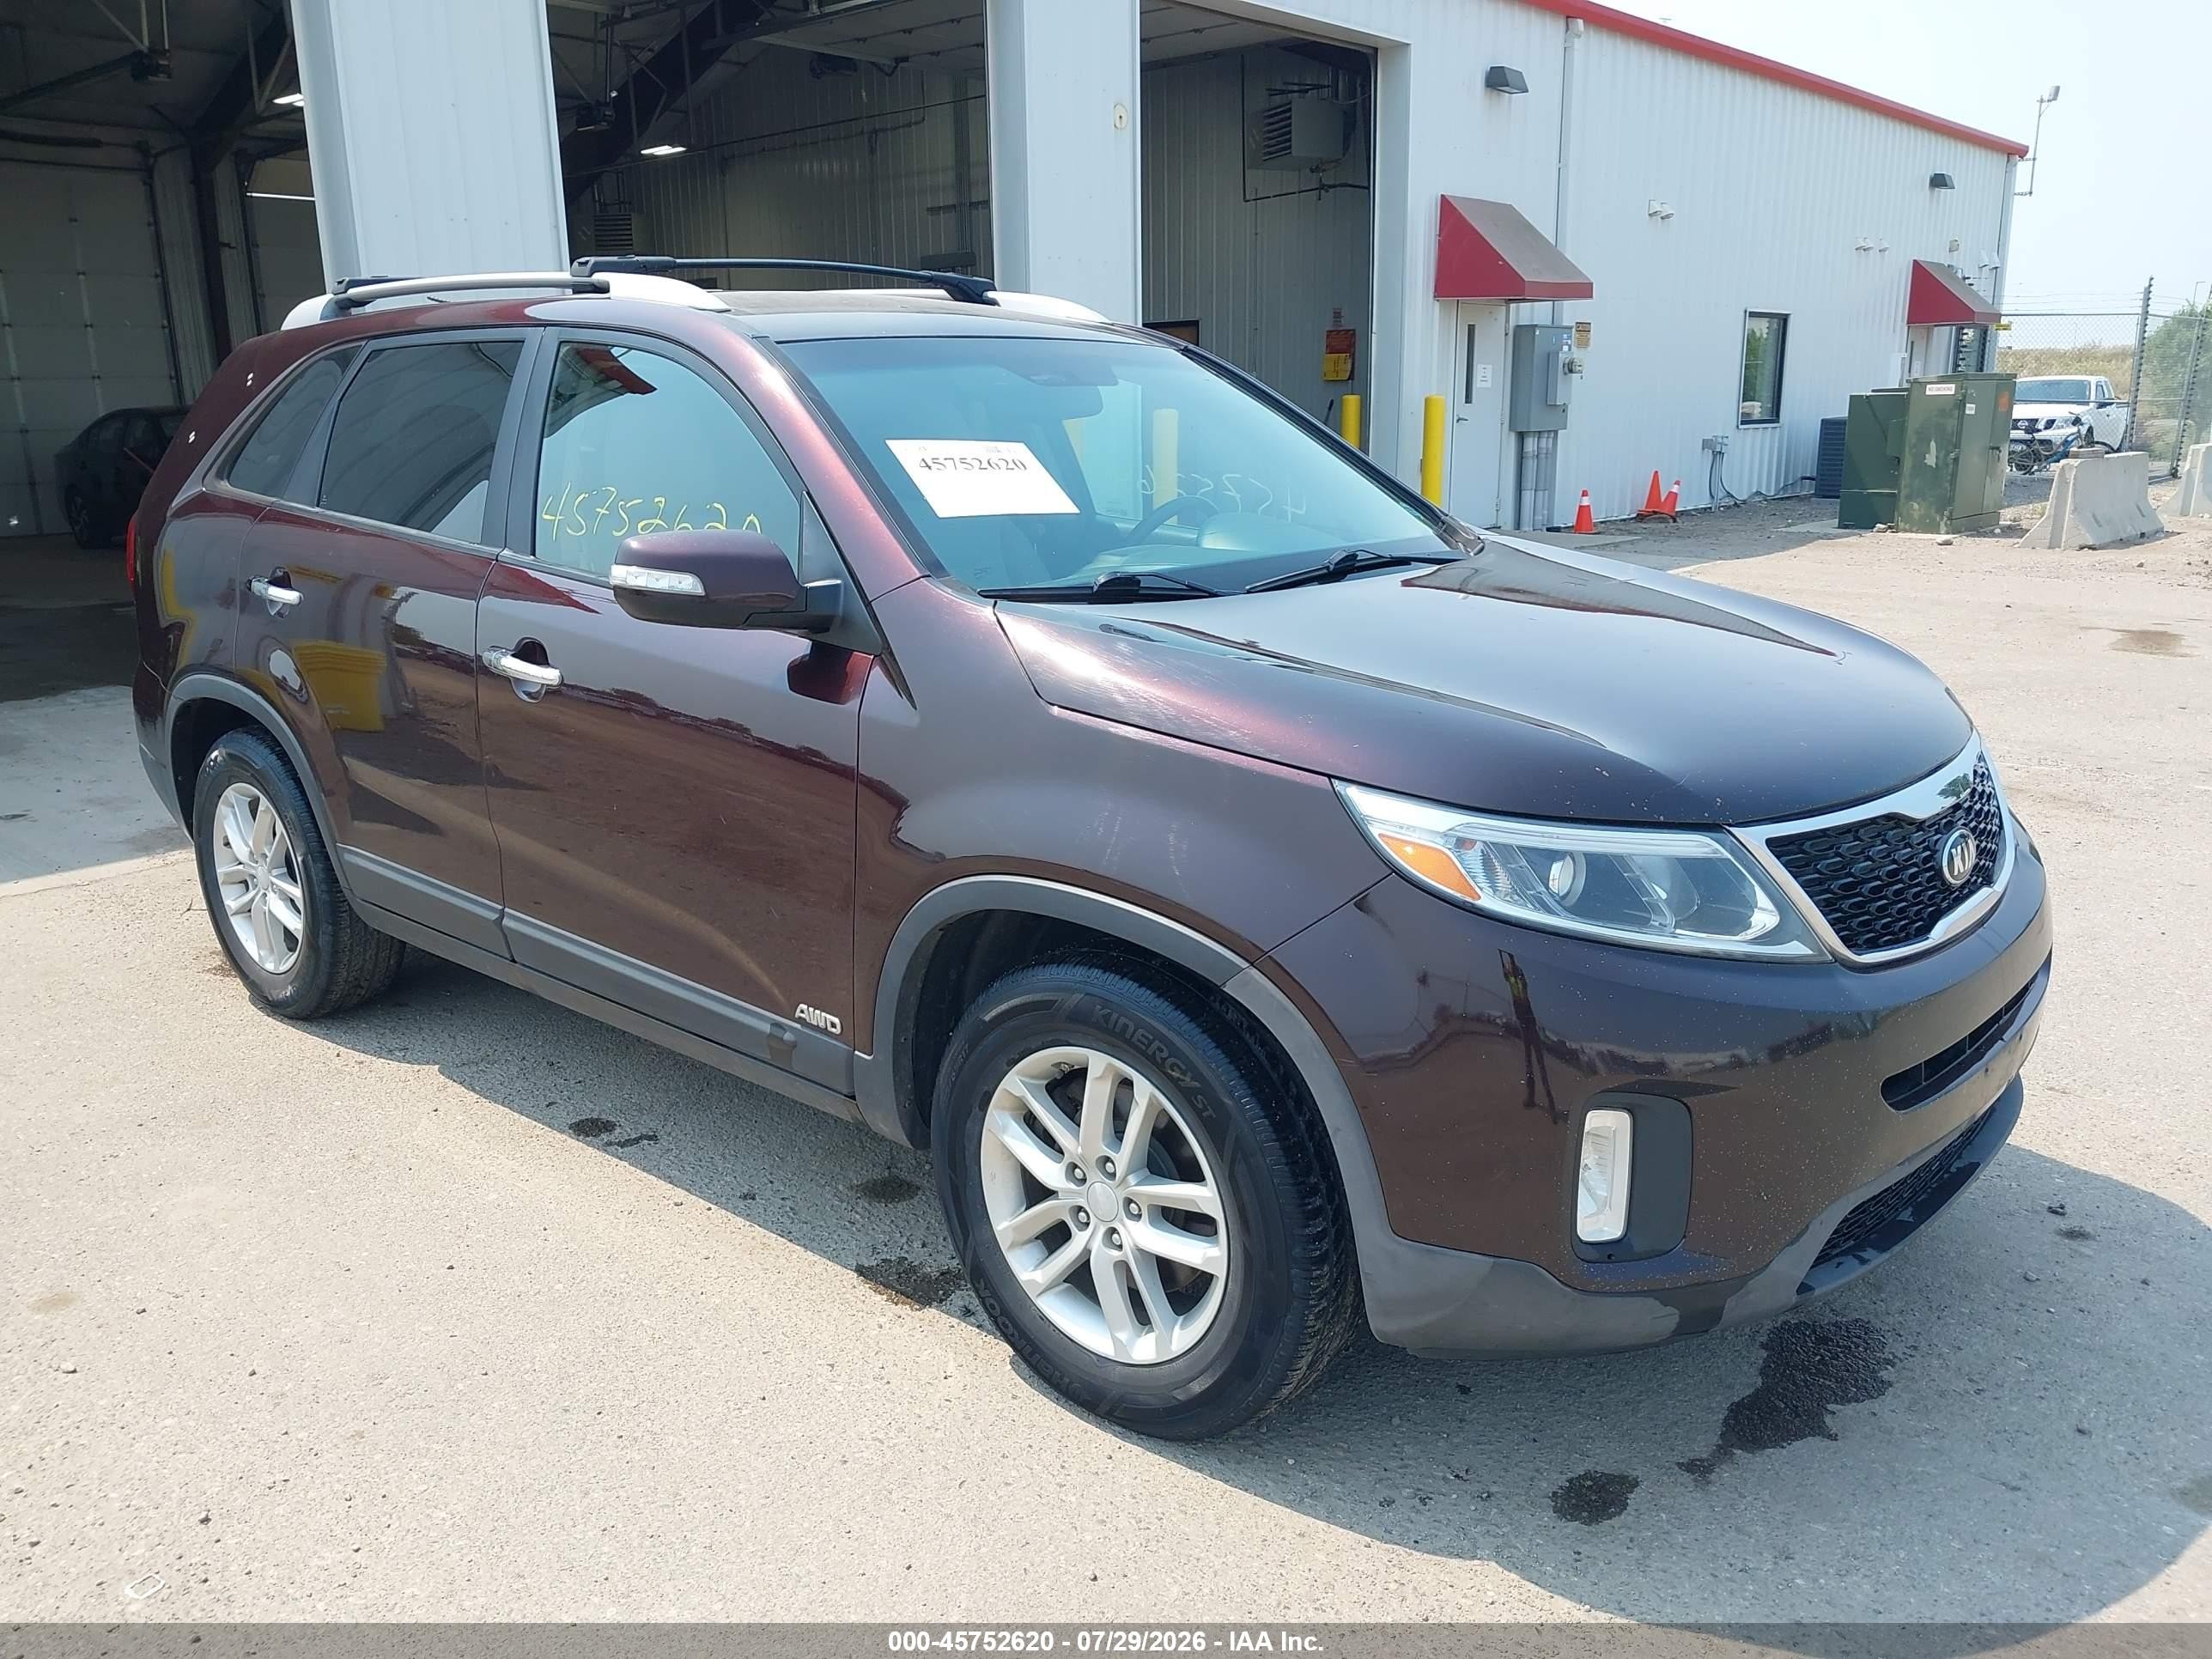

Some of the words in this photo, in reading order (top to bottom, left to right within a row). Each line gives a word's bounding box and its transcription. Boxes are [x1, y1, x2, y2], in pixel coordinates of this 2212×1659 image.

[919, 458, 1027, 471] 45752620
[795, 1003, 842, 1035] AWD
[1091, 1005, 1201, 1088] KINERGY
